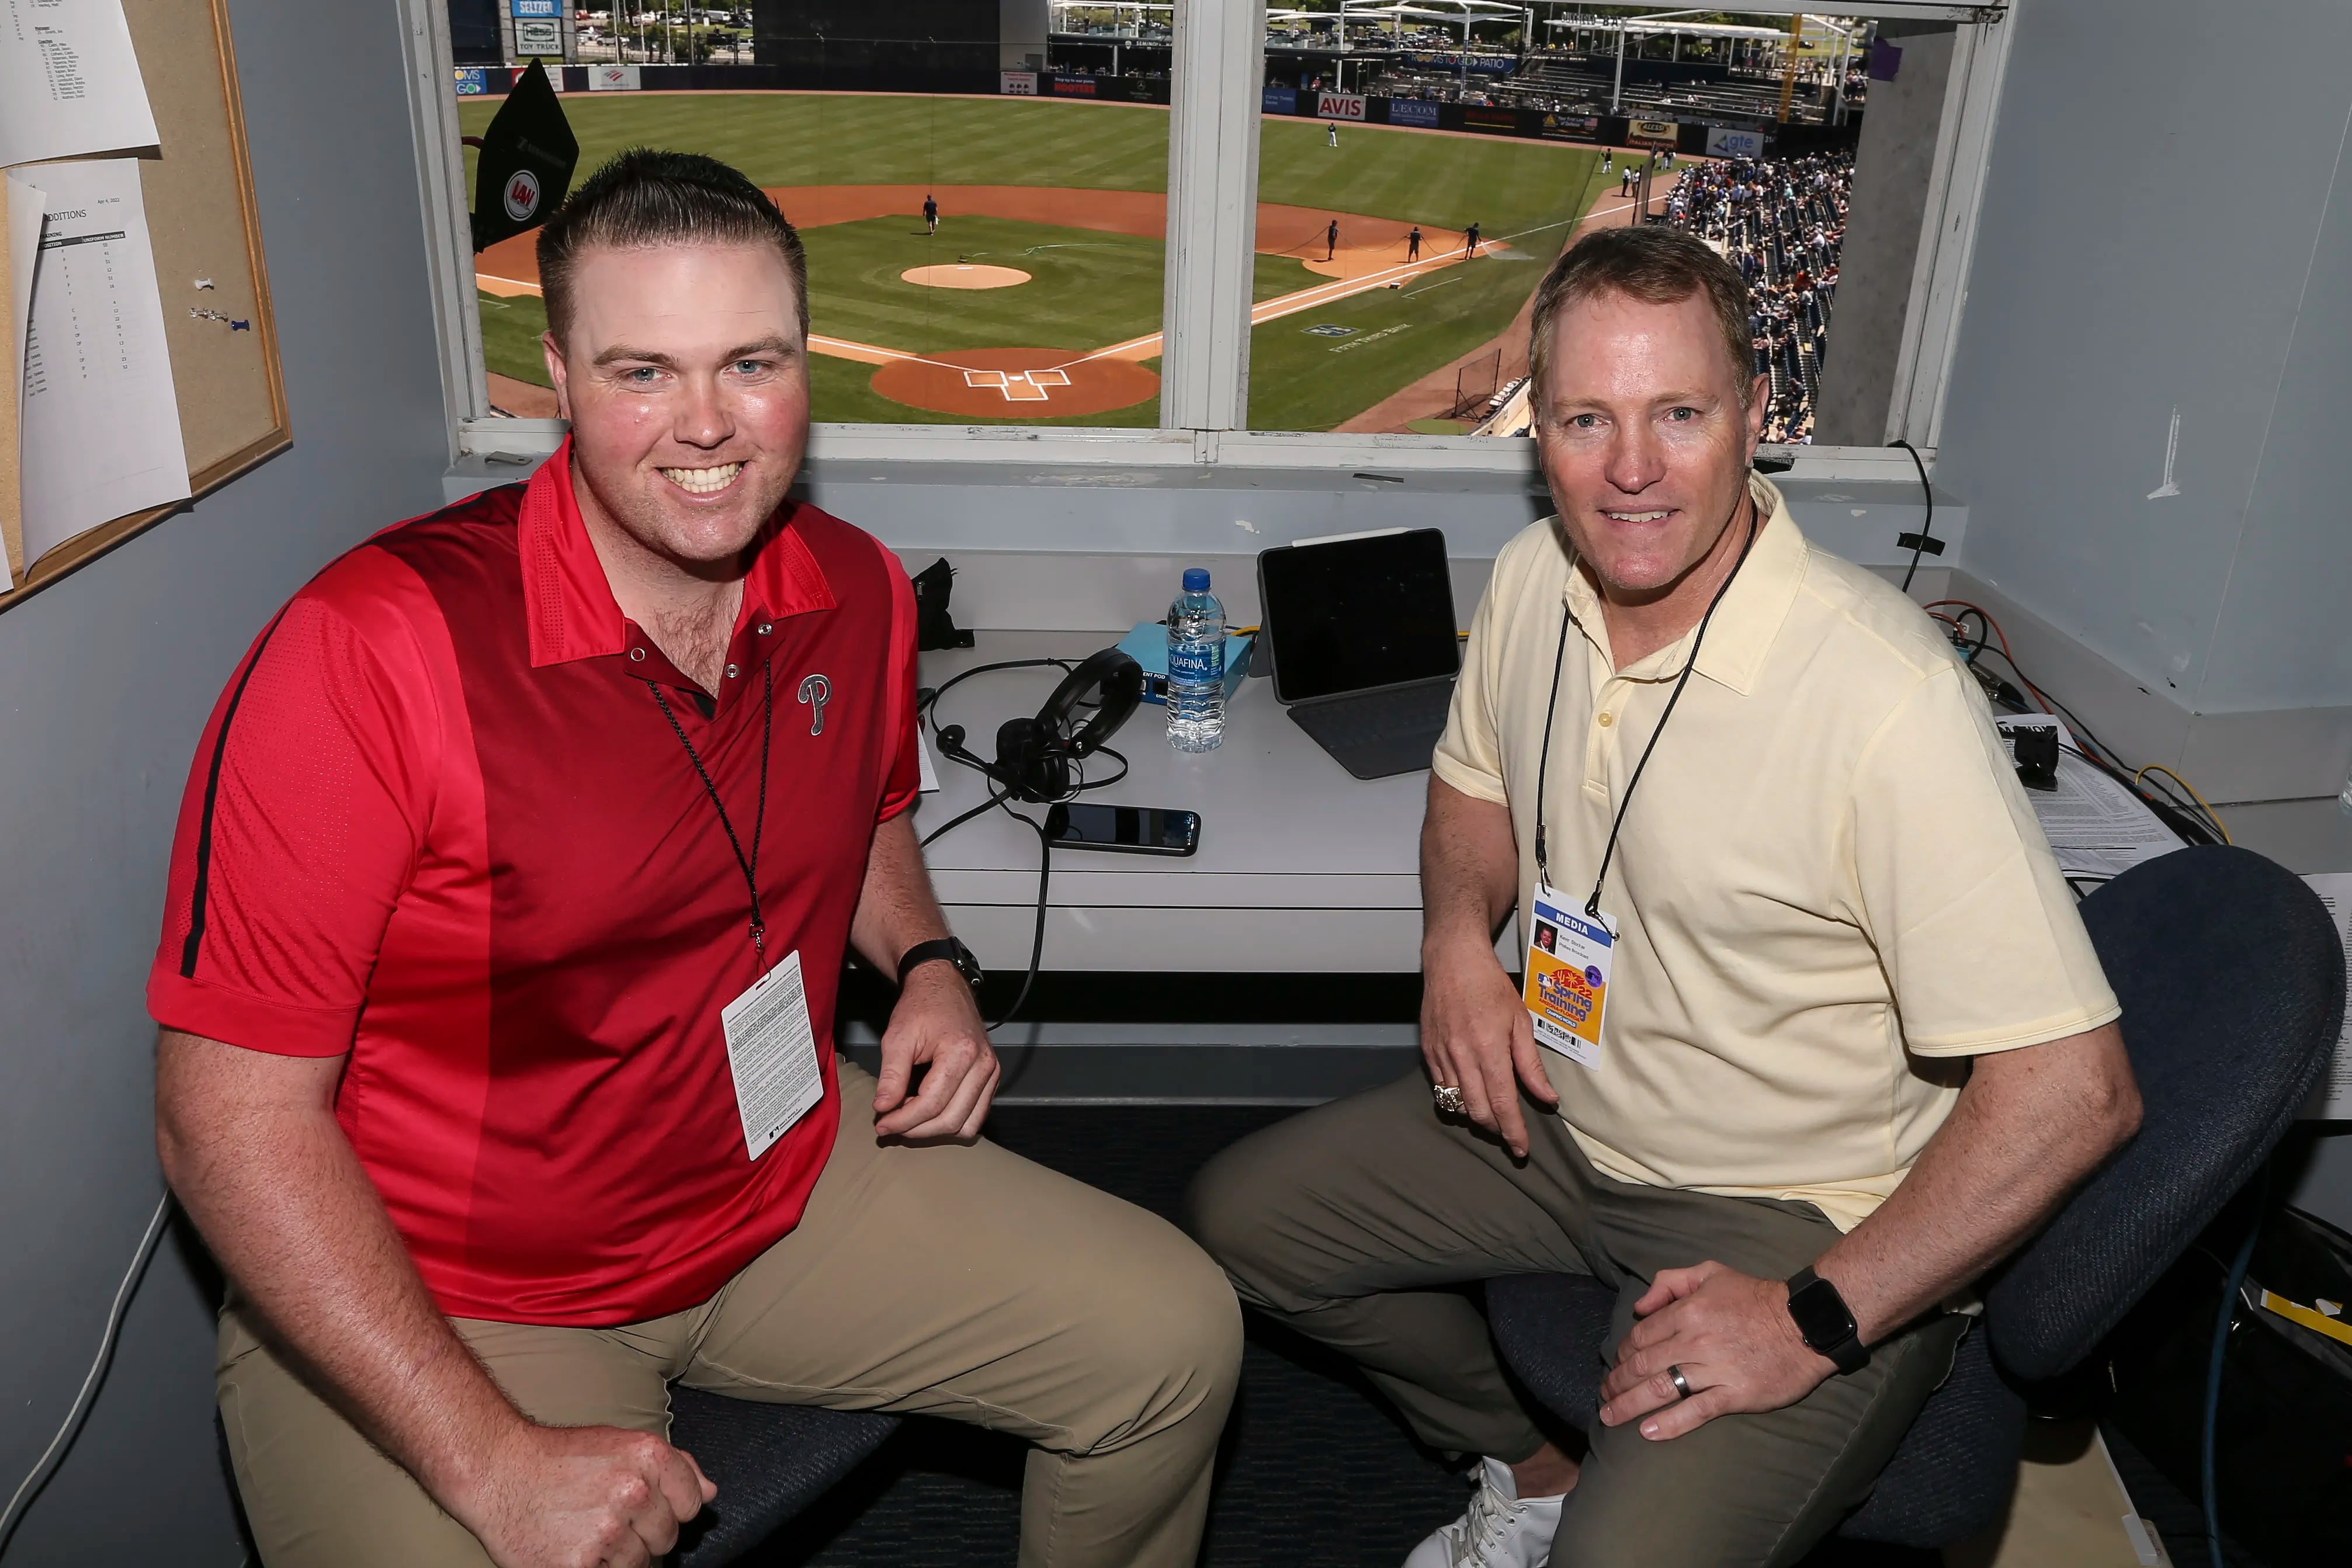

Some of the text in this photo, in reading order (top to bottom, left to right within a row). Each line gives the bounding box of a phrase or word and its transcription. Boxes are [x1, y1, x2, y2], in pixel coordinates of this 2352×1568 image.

[1480, 59, 1504, 68] PATIO
[457, 84, 476, 94] GO
[1319, 98, 1361, 116] AVIS
[1643, 123, 1664, 131] ALESSI
[1730, 135, 1753, 150] gte
[44, 210, 87, 222] ADDITIONS
[797, 674, 832, 736] P
[1556, 912, 1588, 935] MEDIA
[1539, 983, 1586, 1022] Training
[1554, 981, 1593, 1012] Spring 22
